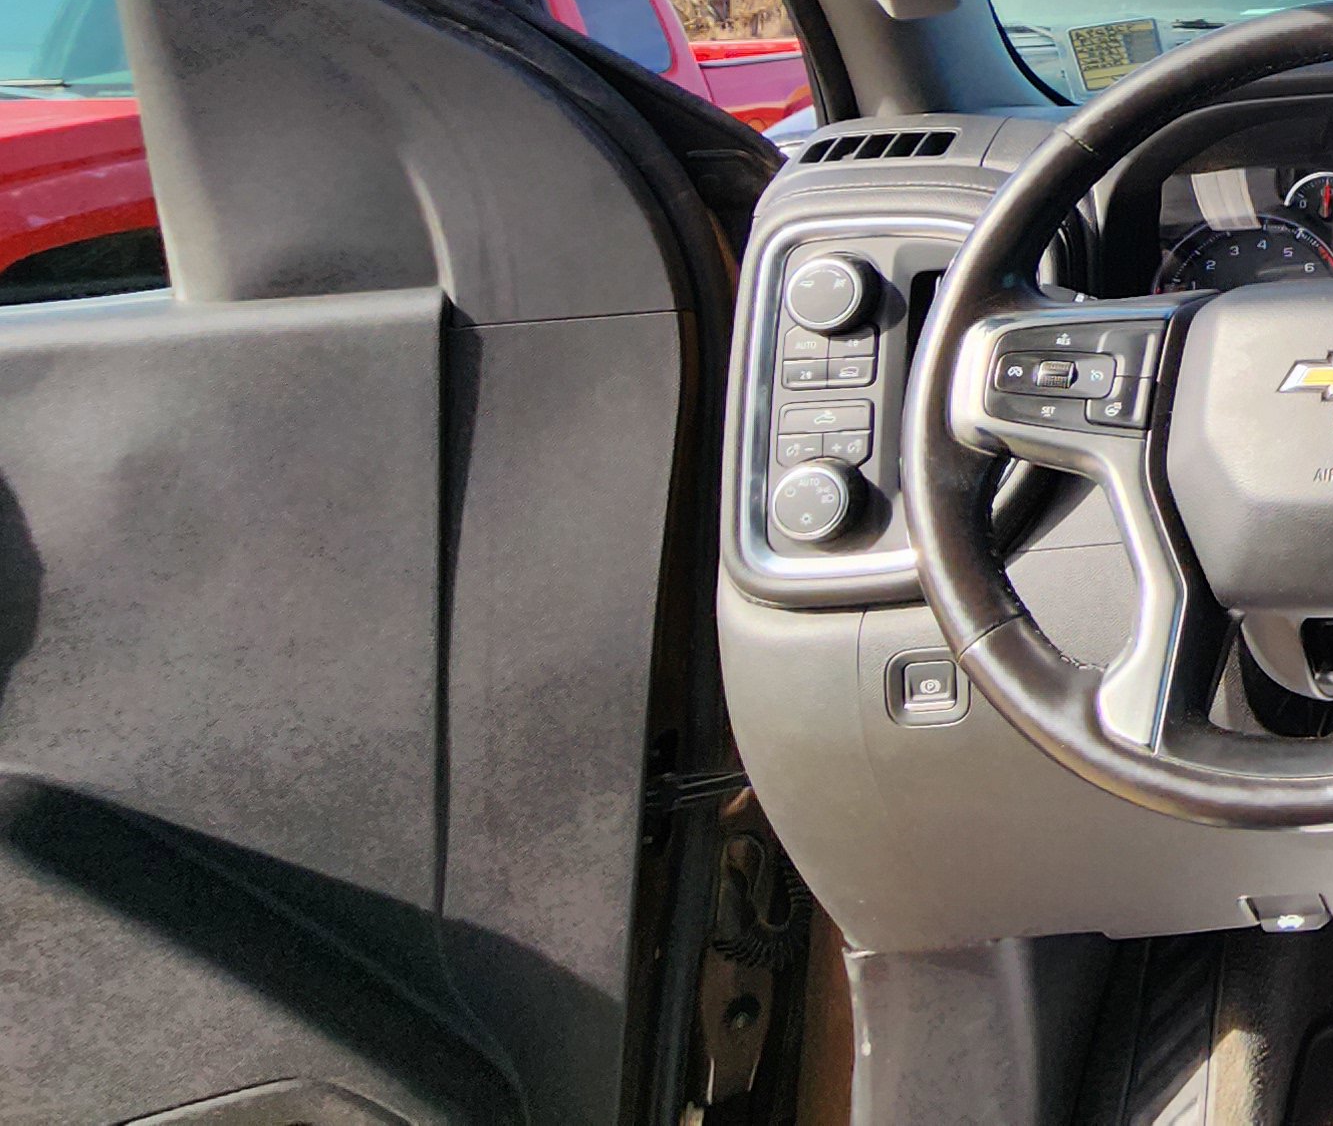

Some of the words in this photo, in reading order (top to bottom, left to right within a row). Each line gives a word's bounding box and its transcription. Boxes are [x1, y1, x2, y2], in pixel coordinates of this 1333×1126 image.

[1256, 239, 1267, 250] 4
[1229, 245, 1240, 256] 3
[1283, 247, 1294, 257] 5
[1206, 261, 1216, 270] 2
[1304, 262, 1315, 272] 6
[1041, 406, 1056, 415] SET
